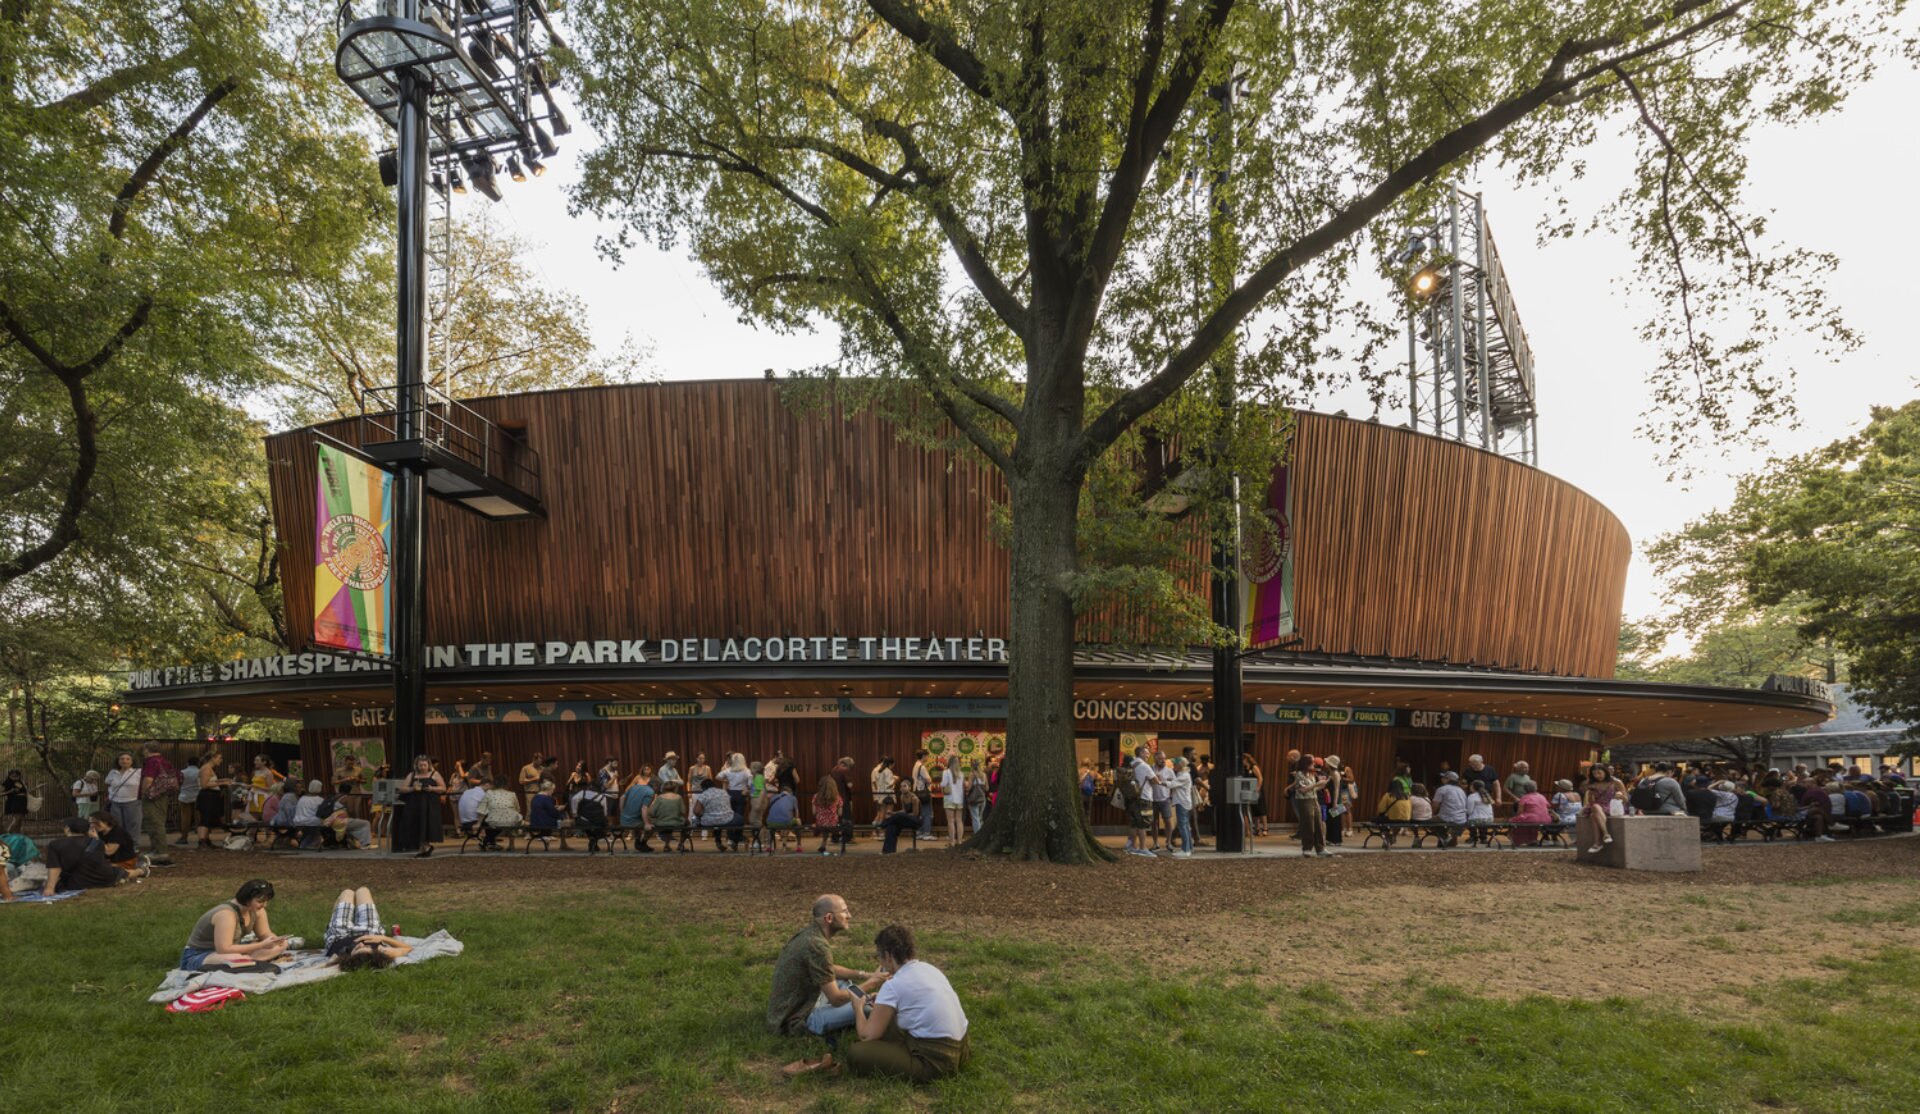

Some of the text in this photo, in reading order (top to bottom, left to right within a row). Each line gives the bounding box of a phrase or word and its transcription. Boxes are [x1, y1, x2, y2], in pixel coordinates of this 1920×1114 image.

[465, 643, 536, 666] THE
[545, 639, 647, 664] PARK
[660, 637, 1006, 662] DELACORTE THEATER
[351, 708, 387, 727] GATE
[597, 703, 698, 716] TWELFTH NIGHT
[783, 704, 803, 713] AUG
[805, 704, 811, 713] 7
[1073, 700, 1203, 721] CONCESSIONS
[1312, 710, 1328, 720] FOR
[1411, 710, 1451, 729] GATE 3
